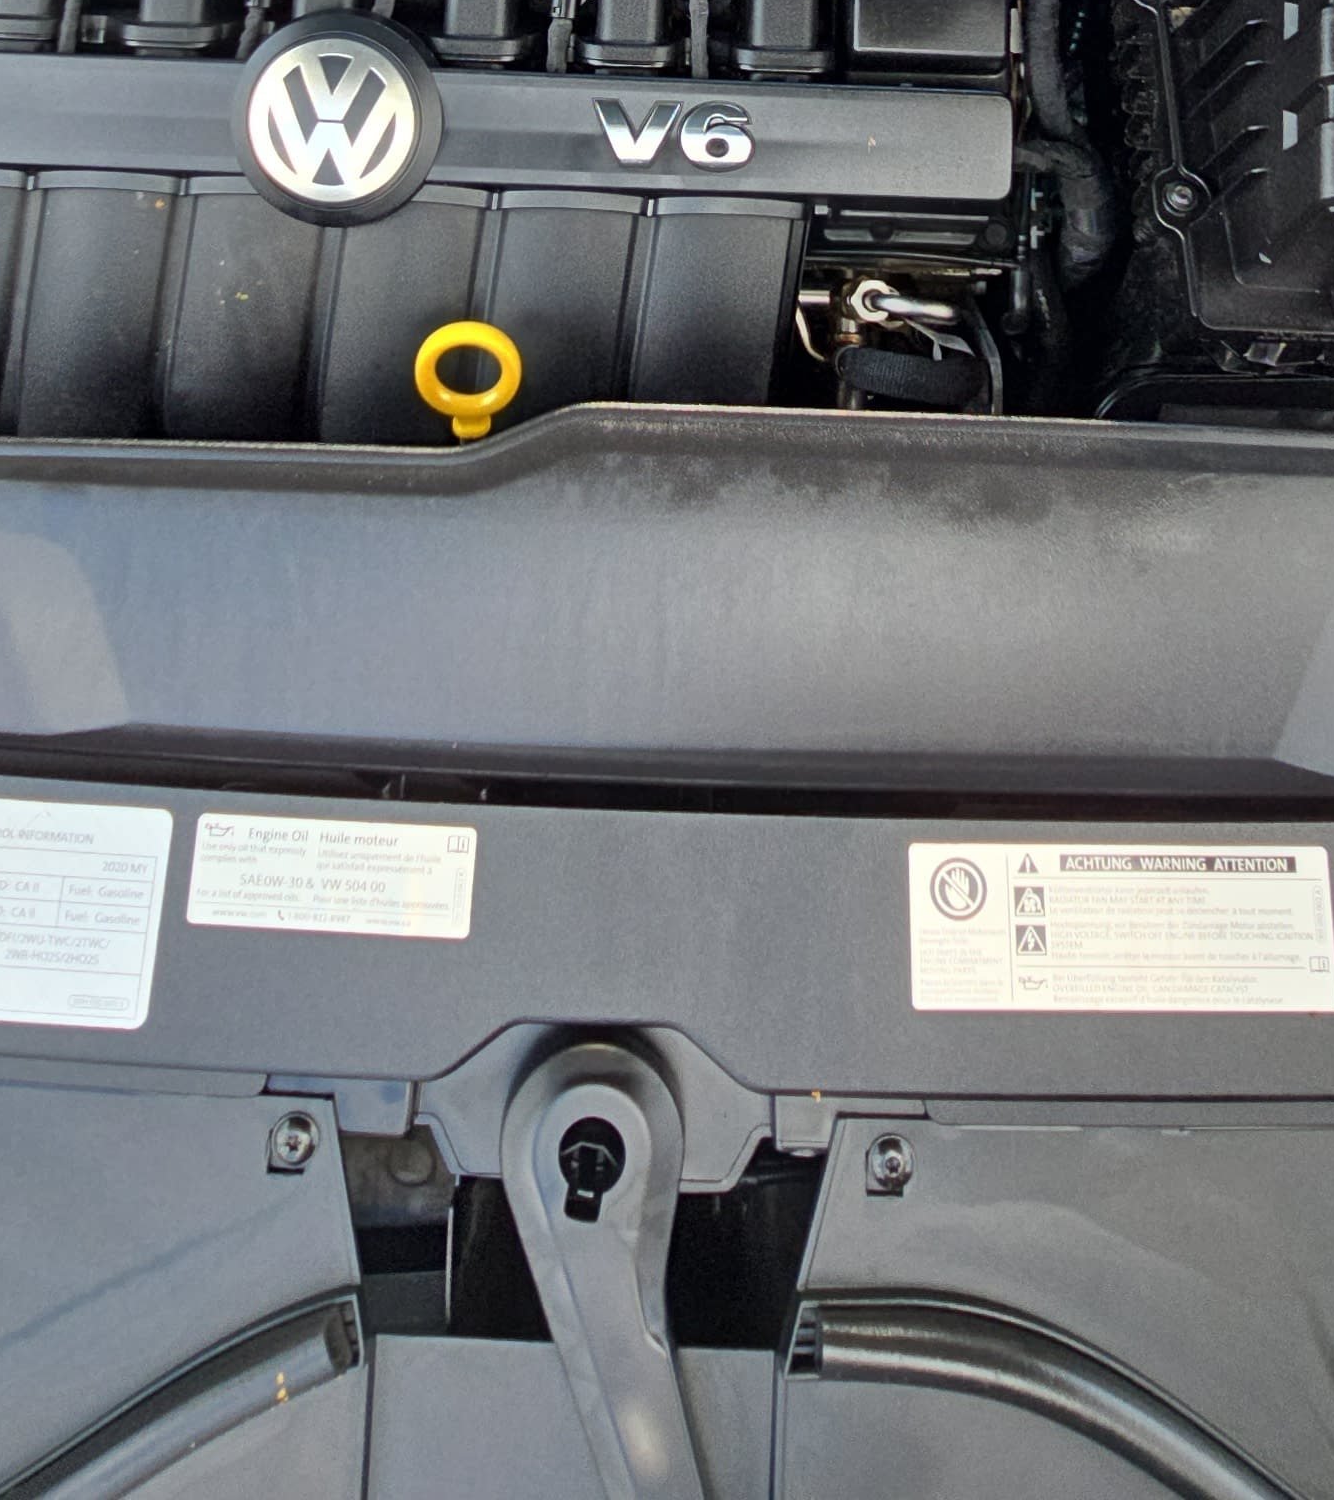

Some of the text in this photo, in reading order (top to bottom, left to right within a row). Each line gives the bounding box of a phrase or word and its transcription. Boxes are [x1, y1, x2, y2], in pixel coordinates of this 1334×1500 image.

[248, 37, 415, 201] VW
[592, 97, 755, 172] V6
[18, 828, 94, 844] INFORMATION
[248, 828, 309, 844] Engine Oil
[319, 831, 399, 847] Huile moteur
[102, 860, 148, 874] 2020 MY
[1065, 856, 1287, 871] ACHTUNG WARNING ATTENTION
[15, 881, 30, 892] CA
[305, 876, 315, 889] &
[320, 878, 342, 891] VW
[345, 879, 367, 892] 504
[370, 881, 386, 893] 00
[98, 886, 144, 900] Gasoline
[11, 907, 26, 918] CA
[94, 911, 140, 925] Gasoline
